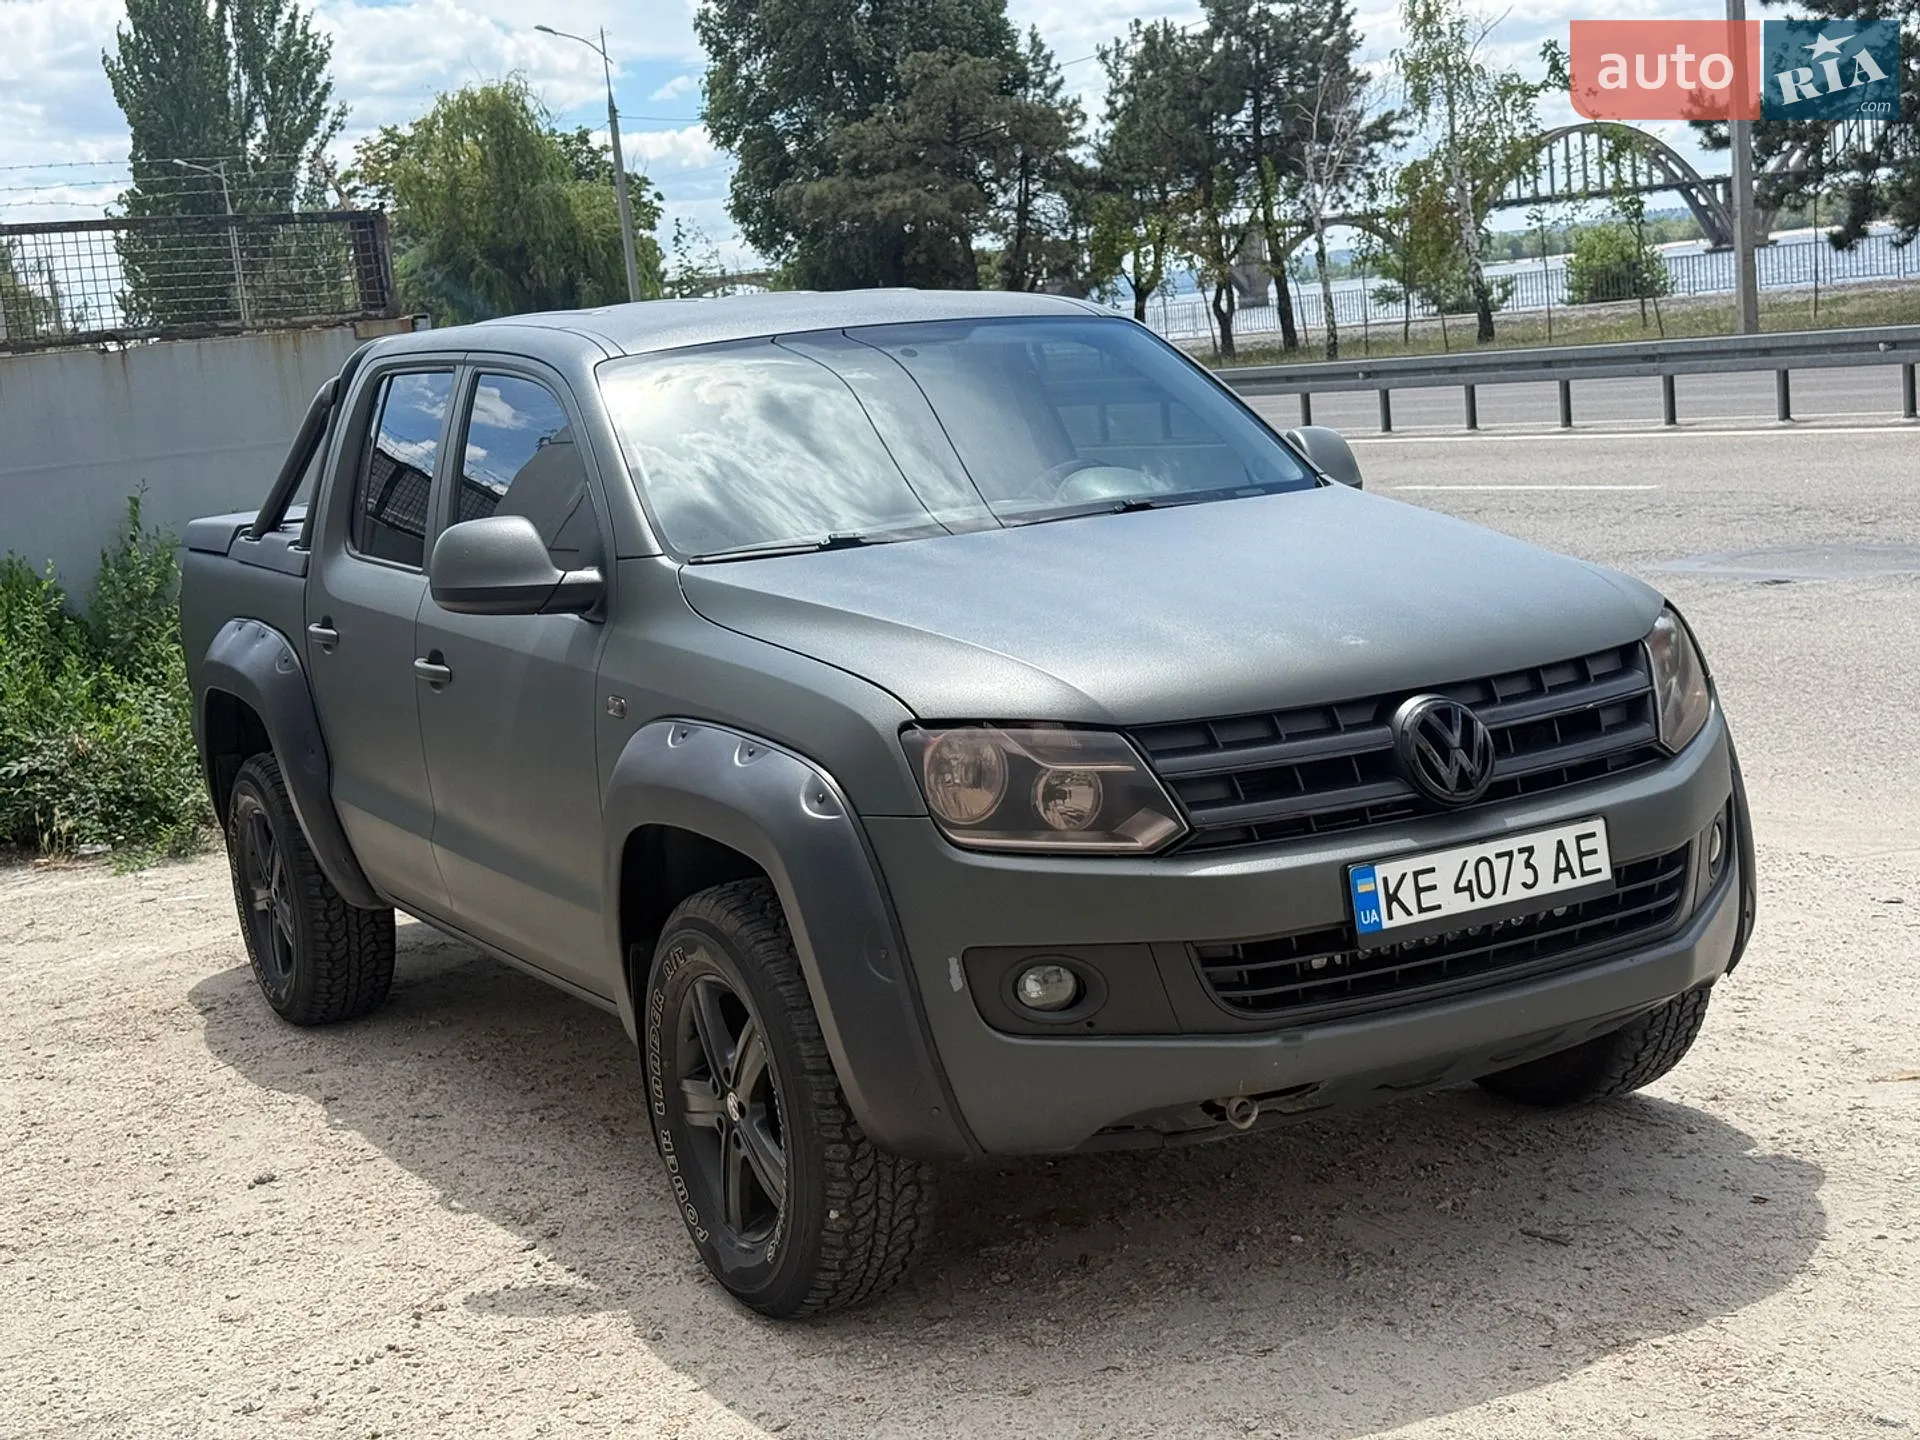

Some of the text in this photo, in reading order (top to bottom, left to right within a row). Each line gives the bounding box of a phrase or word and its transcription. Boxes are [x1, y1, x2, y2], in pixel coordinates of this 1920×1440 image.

[1361, 909, 1379, 925] UA
[1382, 831, 1602, 921] KE 4073 AE
[660, 1129, 709, 1242] POWER
